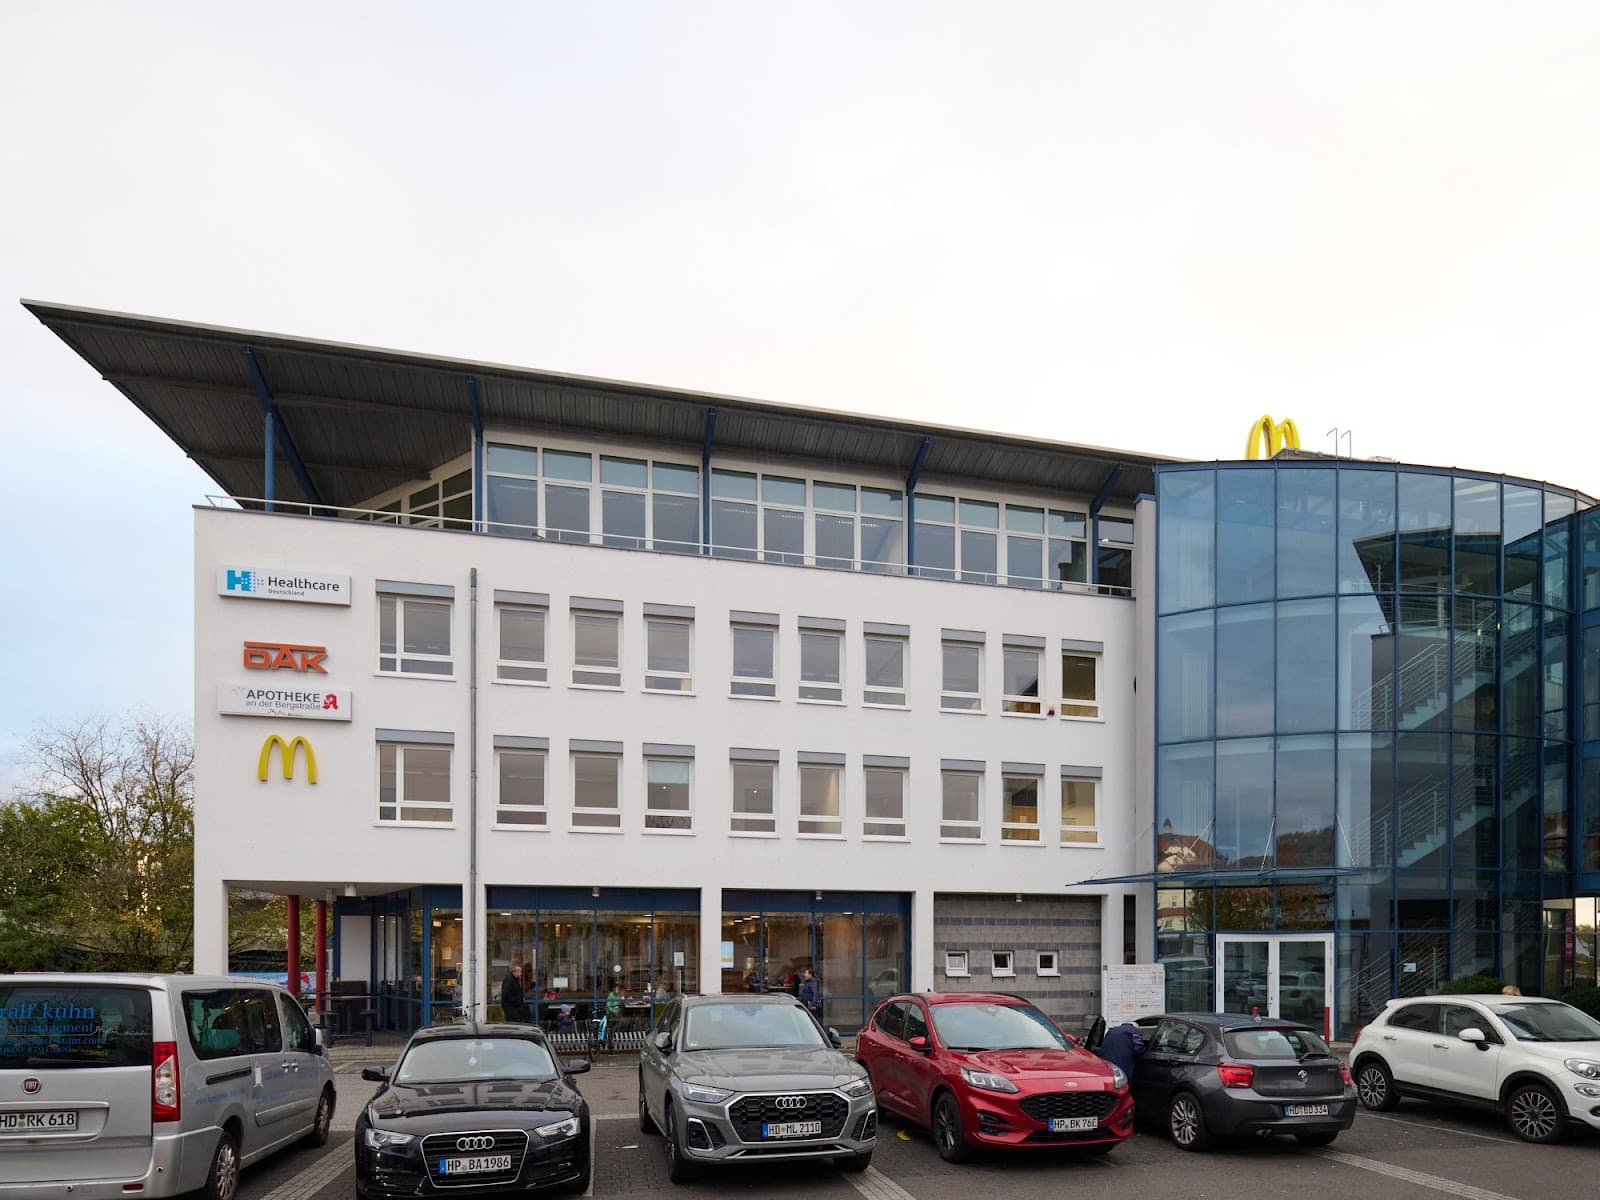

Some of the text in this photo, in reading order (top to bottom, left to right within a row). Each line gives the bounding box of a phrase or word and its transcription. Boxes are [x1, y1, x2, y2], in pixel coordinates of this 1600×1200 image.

[267, 576, 340, 592] Healthcare
[268, 588, 305, 596] Deutschland
[244, 641, 328, 674] DAK
[246, 689, 321, 703] APOTHEKE
[259, 699, 272, 708] der
[275, 700, 321, 711] Bergstraße
[258, 734, 318, 784] M
[42, 1001, 96, 1019] kuhn
[0, 1113, 75, 1128] HD RK 618
[1054, 1118, 1097, 1129] HP BK 76E
[768, 1122, 820, 1135] HD ML 2110
[447, 1156, 509, 1171] HP BA 1986
